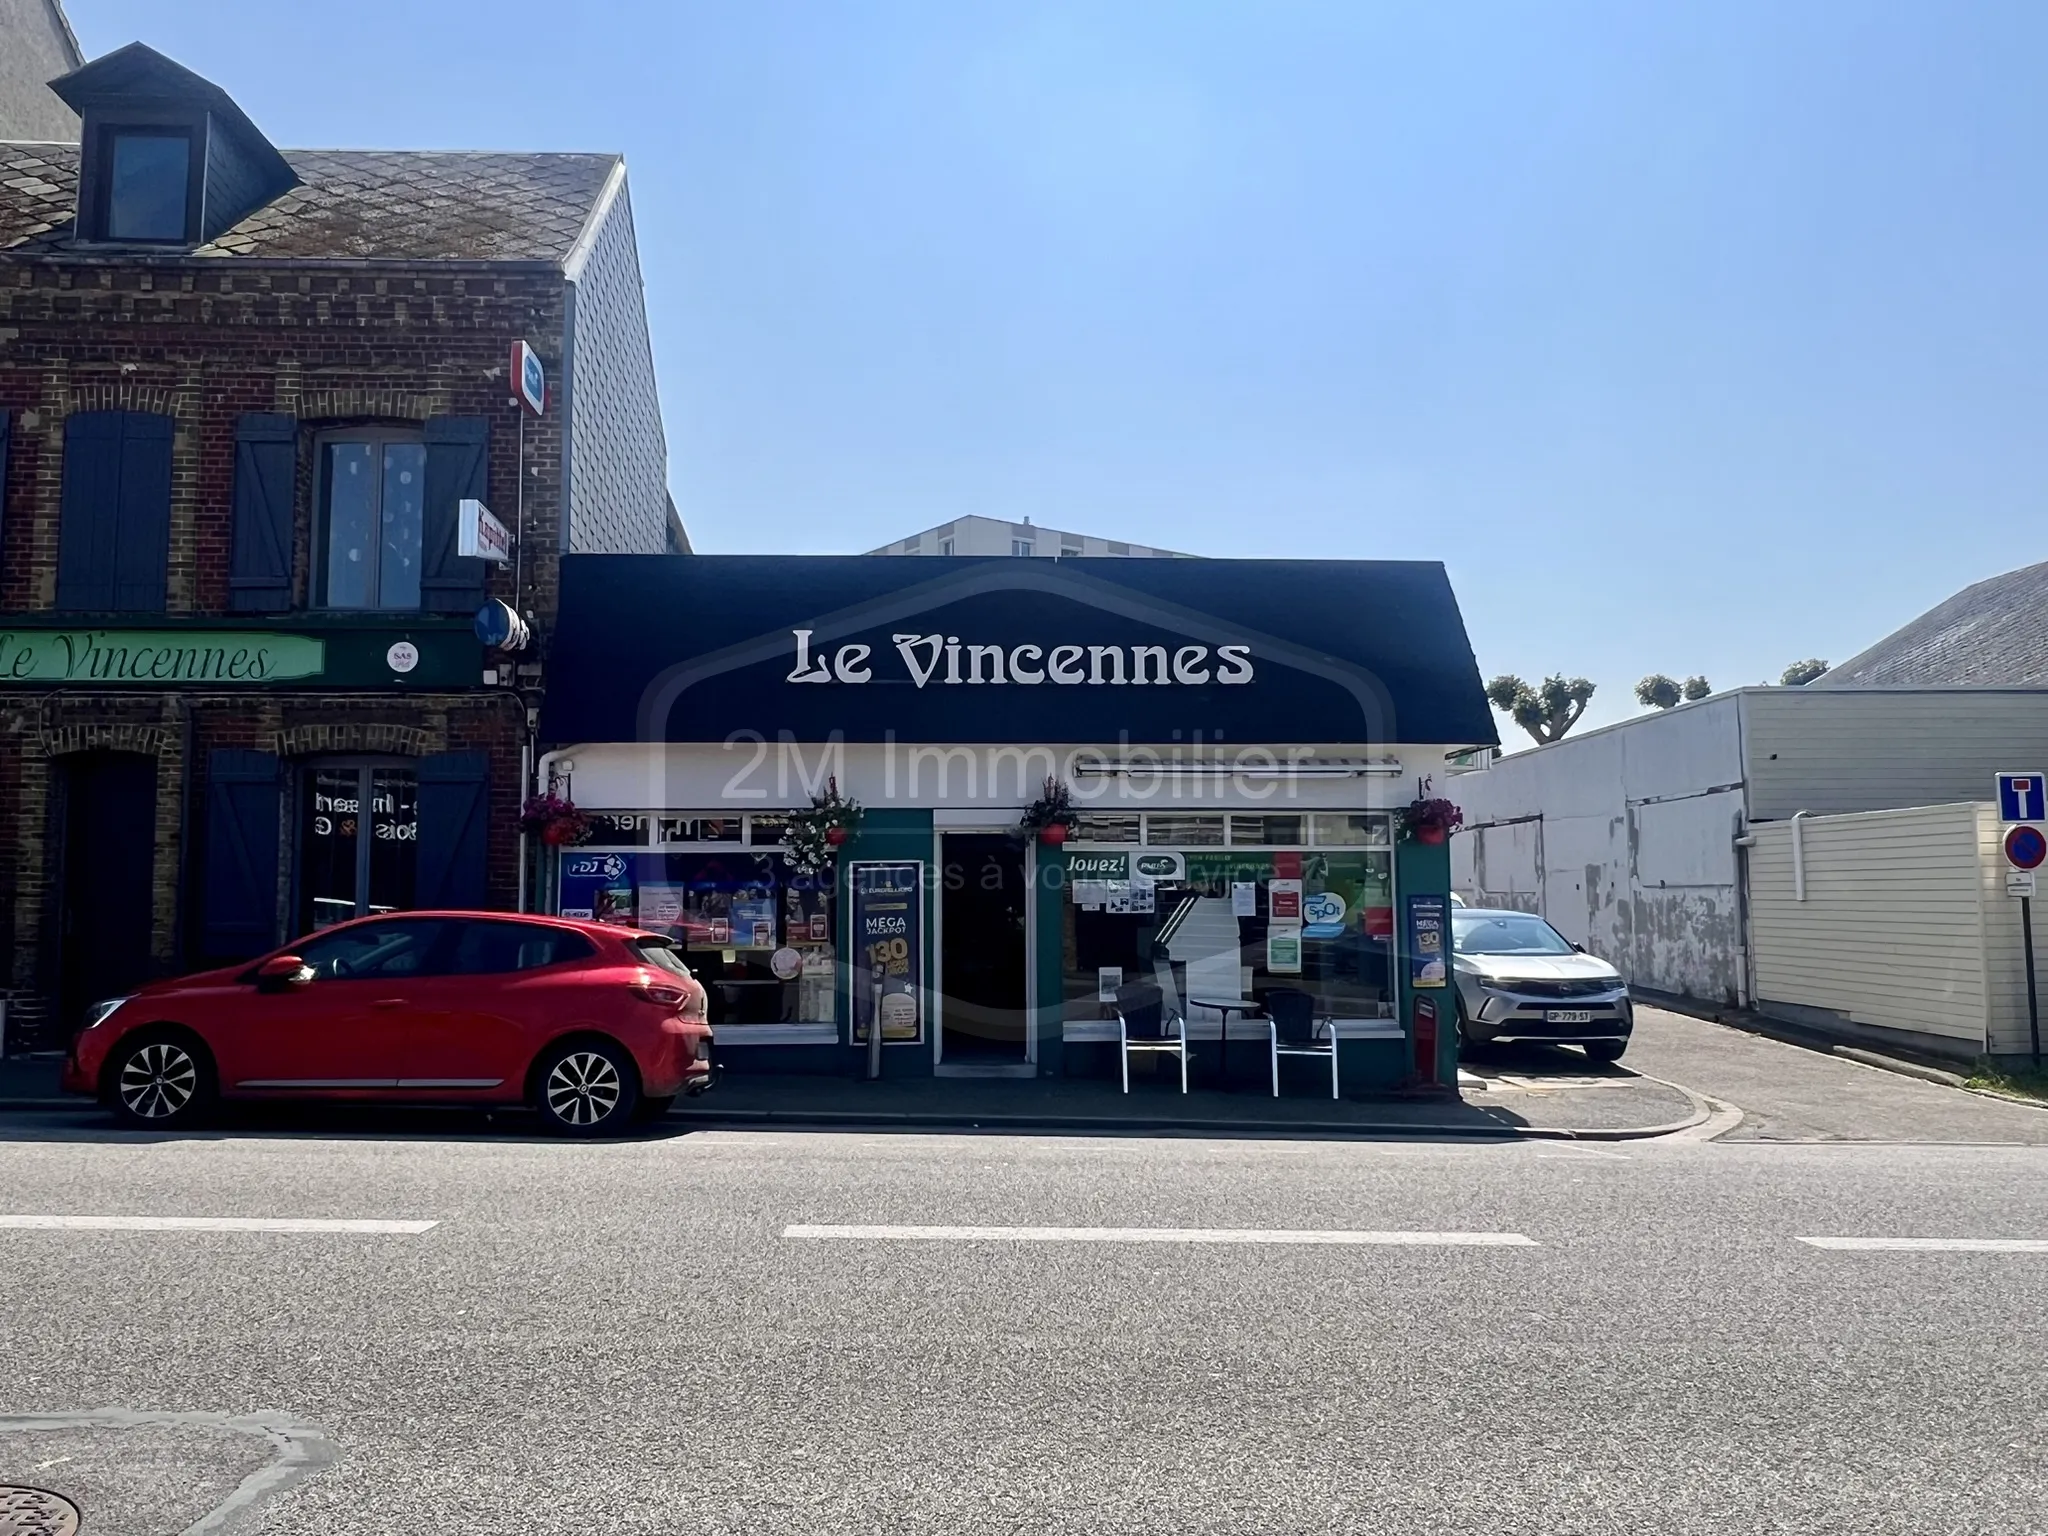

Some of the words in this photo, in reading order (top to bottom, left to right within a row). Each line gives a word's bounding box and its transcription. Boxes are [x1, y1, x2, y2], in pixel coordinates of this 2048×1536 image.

[52, 632, 278, 678] Vincennes
[786, 629, 872, 683] Le
[892, 633, 1254, 688] Vincennes
[1067, 854, 1125, 872] Jouez!
[866, 917, 906, 928] MEGA
[867, 926, 906, 935] JACKPOT
[865, 938, 908, 964] 130
